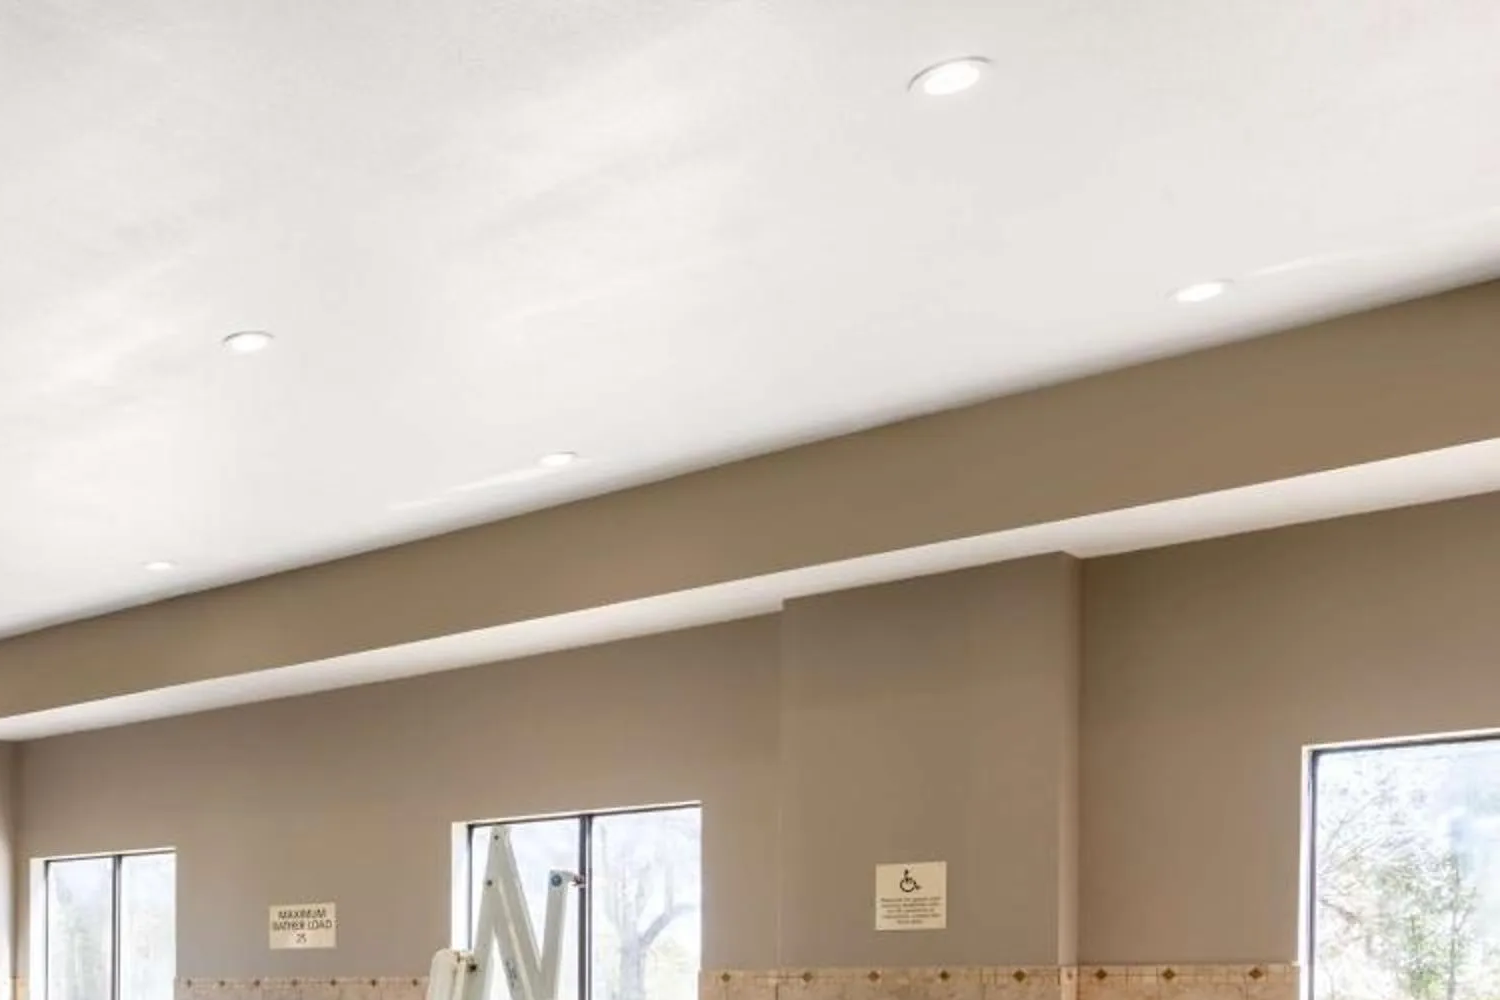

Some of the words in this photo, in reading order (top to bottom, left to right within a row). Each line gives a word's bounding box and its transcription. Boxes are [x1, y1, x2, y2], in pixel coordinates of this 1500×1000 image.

[278, 908, 326, 919] MAXIMUM
[272, 921, 304, 931] BATHER
[308, 919, 333, 930] LOAD
